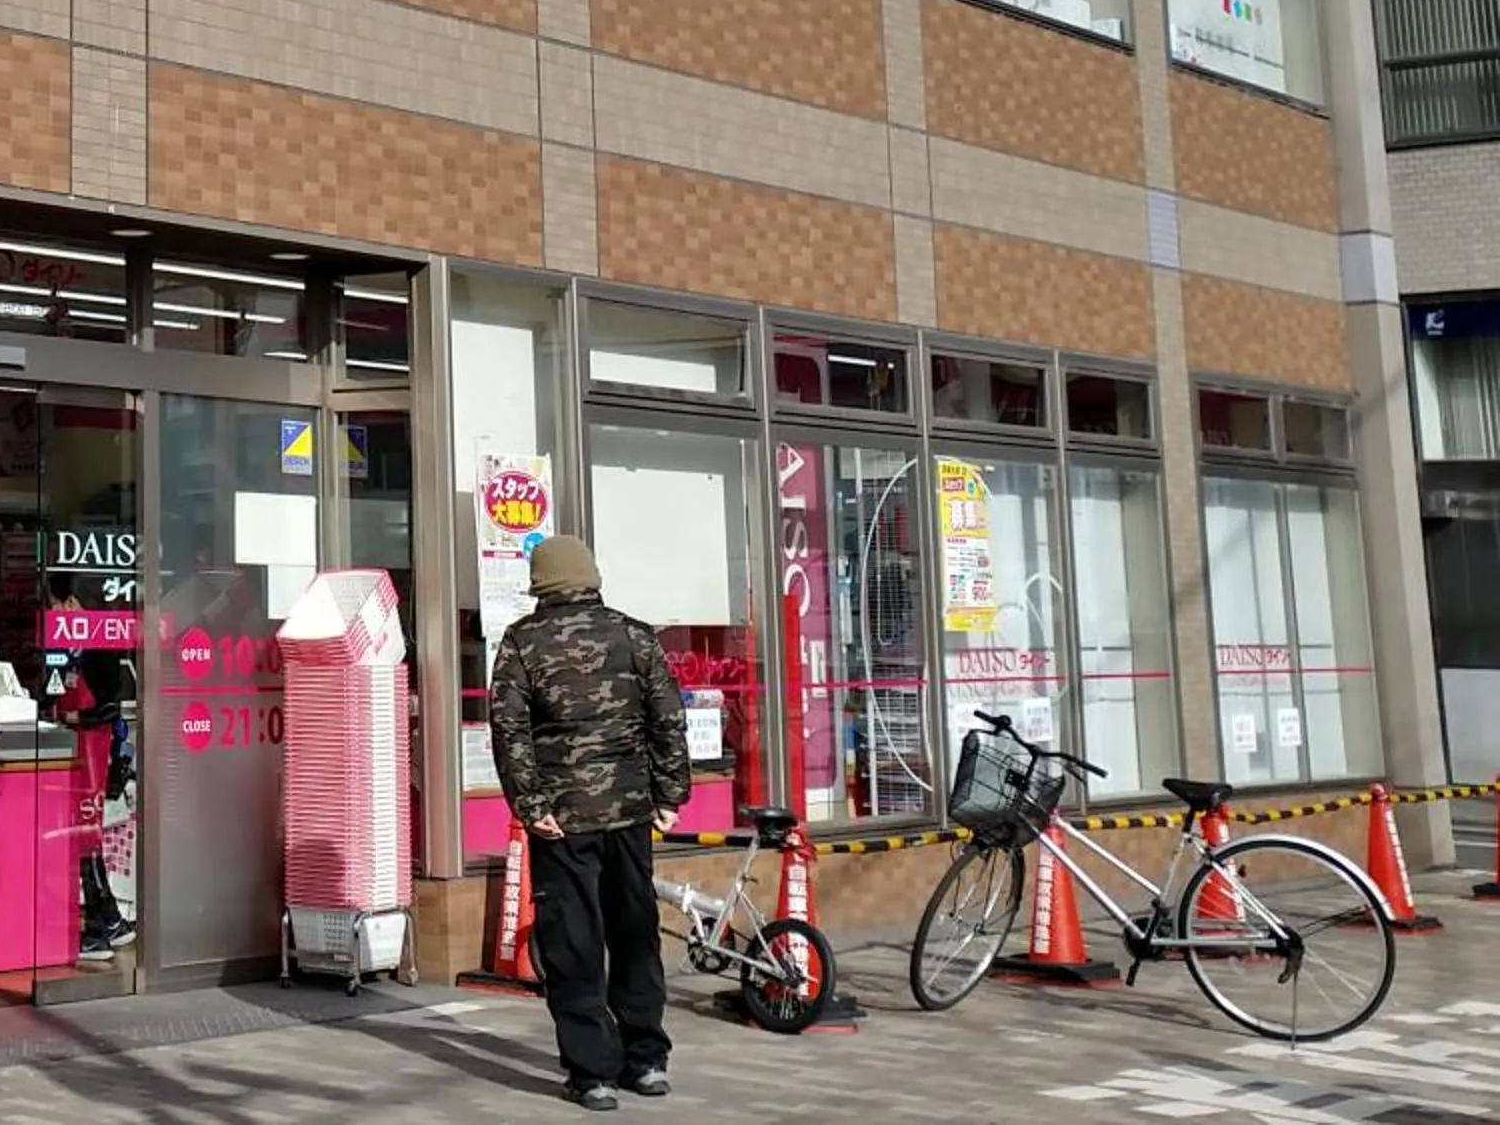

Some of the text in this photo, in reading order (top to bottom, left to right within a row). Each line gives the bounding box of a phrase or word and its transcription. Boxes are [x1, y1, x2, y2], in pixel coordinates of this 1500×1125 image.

[491, 478, 541, 500] スタッフ
[491, 499, 542, 526] 大募集!
[56, 531, 137, 565] DAIS
[102, 576, 137, 603] ダイ
[181, 647, 212, 662] OPEN
[958, 650, 1017, 674] DAISO
[182, 719, 212, 733] CLOSE
[219, 705, 285, 748] 21:0
